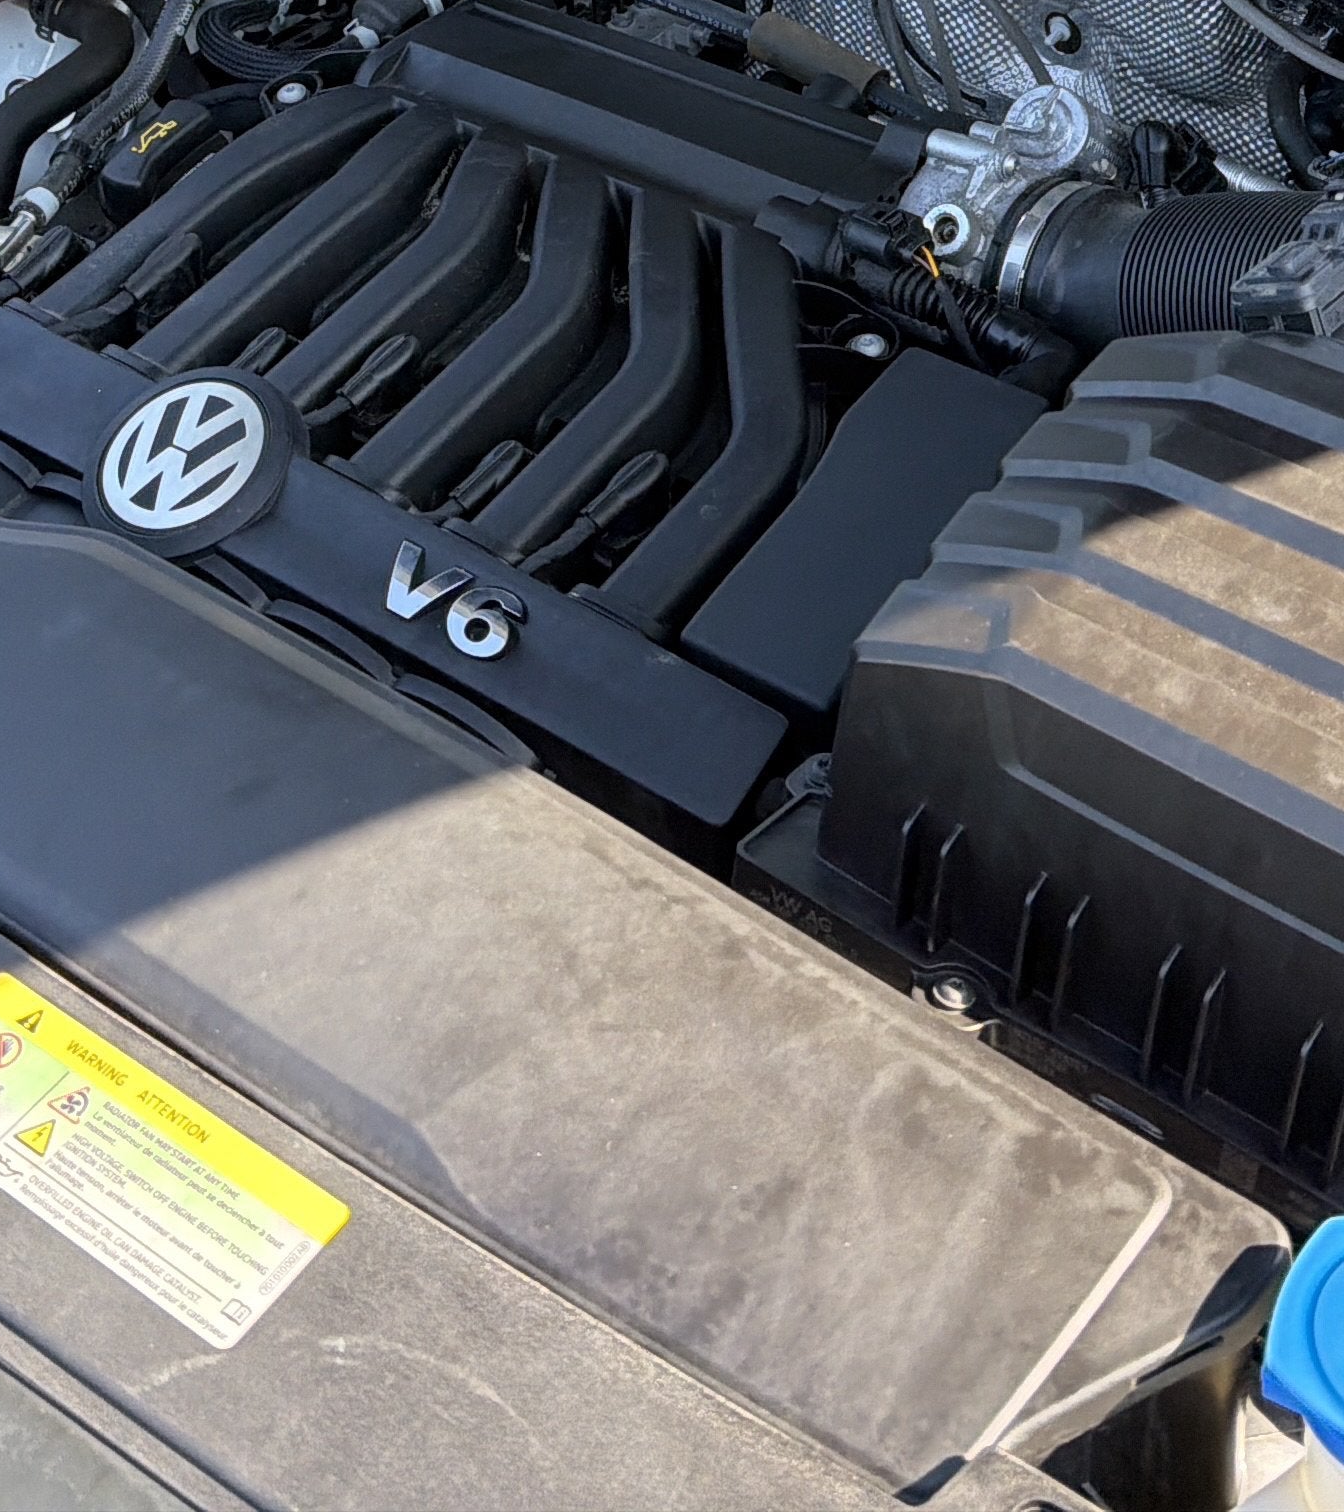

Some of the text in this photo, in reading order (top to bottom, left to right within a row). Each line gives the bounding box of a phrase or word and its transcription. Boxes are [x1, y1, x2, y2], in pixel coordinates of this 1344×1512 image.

[384, 538, 529, 662] V6
[62, 1139, 98, 1167] IGNITION
[63, 1038, 212, 1144] WARNING ATTENTION
[101, 1100, 240, 1200] RADIATOR FAN MAY START AT ANY TIME
[27, 1173, 74, 1210] OVERFILLED
[70, 1205, 103, 1231] ENGINE
[99, 1226, 117, 1241] OIL
[112, 1236, 133, 1253] CAN
[128, 1248, 165, 1277] DAMAGE
[52, 1149, 79, 1170] Haute
[130, 1206, 143, 1217] le
[139, 1213, 170, 1238] moteur
[168, 1234, 194, 1255] avant
[190, 1250, 204, 1262] de
[201, 1258, 235, 1285] toucher
[70, 1131, 269, 1276] HIGH SWITCH OFF ENGINE BEFORE TOUCHING
[91, 1110, 105, 1122] Le
[101, 1117, 145, 1150] ventilateur
[141, 1145, 155, 1157] de
[151, 1152, 190, 1182] radiateur
[185, 1178, 208, 1196] peut
[205, 1192, 217, 1202] se
[264, 1233, 285, 1249] tout
[16, 1182, 67, 1222] Remplissage
[62, 1216, 96, 1242] excessif
[117, 1257, 161, 1292] dangereux
[156, 1287, 179, 1306] pour
[176, 1301, 188, 1312] le
